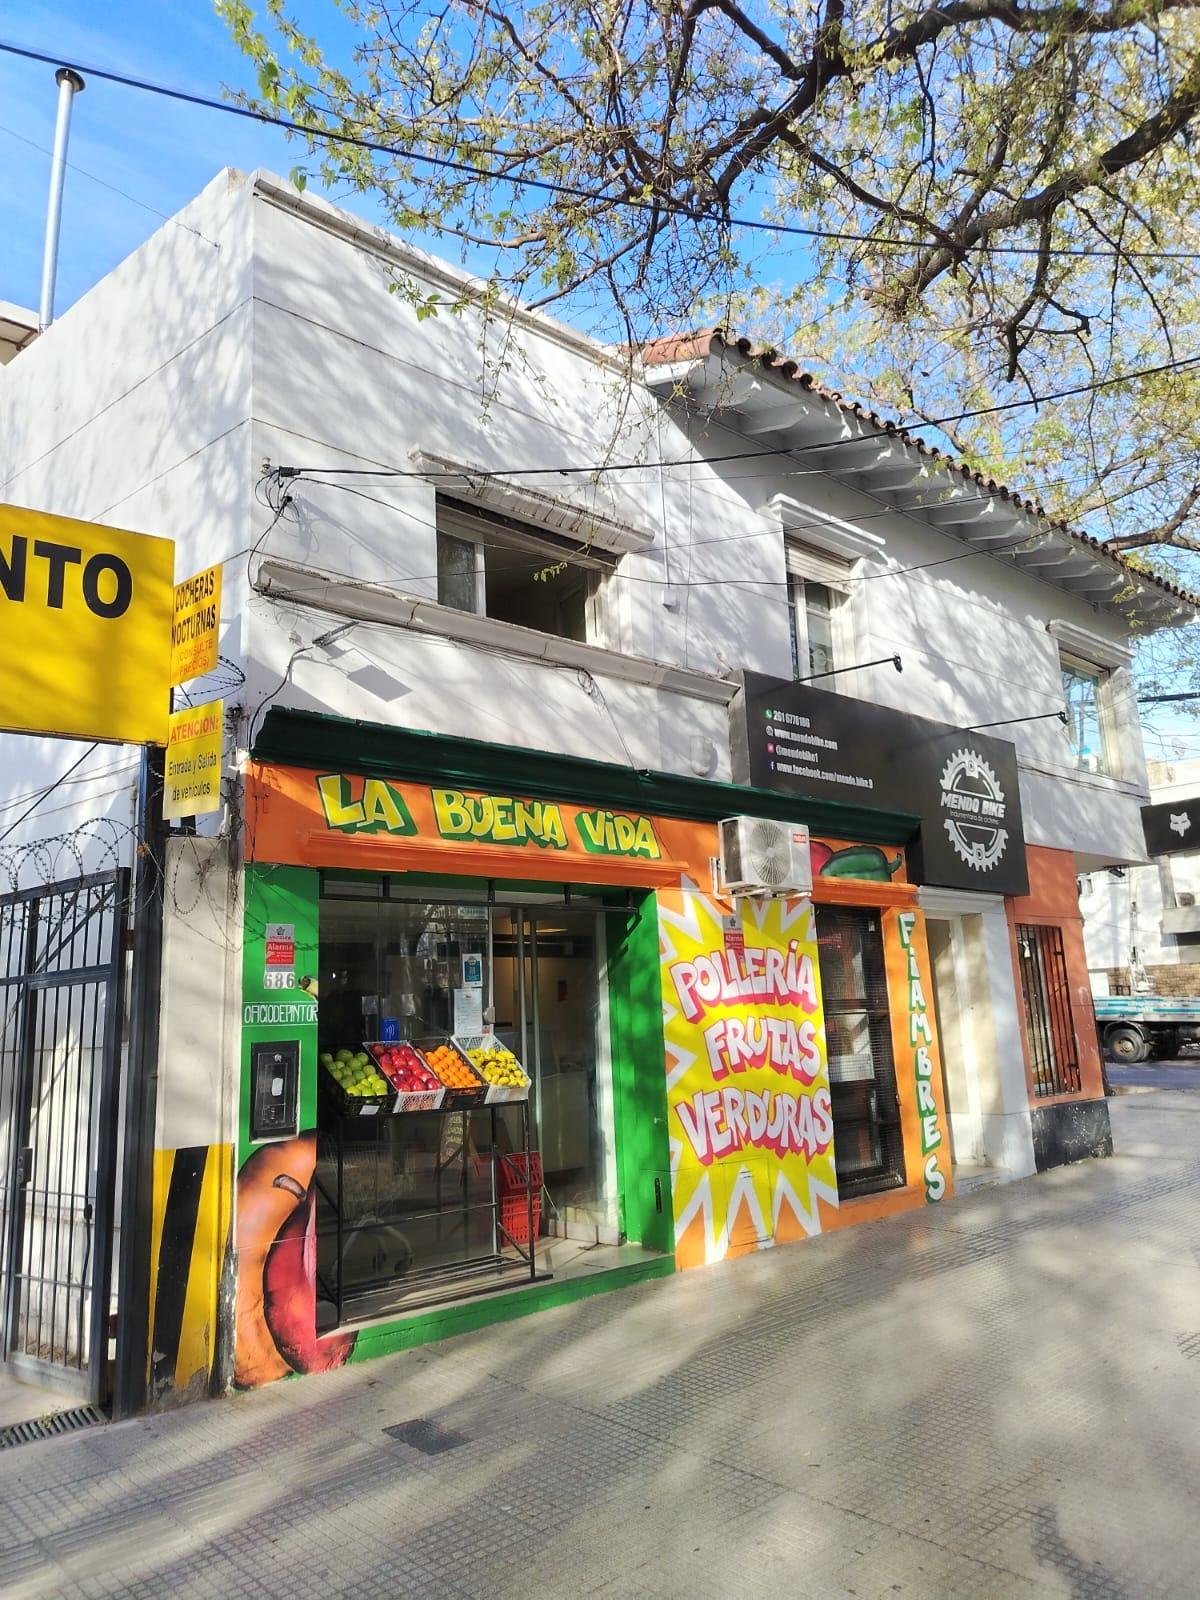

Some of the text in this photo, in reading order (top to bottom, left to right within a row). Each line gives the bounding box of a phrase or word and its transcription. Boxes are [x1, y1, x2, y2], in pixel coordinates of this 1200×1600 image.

[175, 570, 215, 612] COCHERAS
[171, 604, 216, 648] NOCTURNAS
[170, 715, 219, 742] ATENCION:
[168, 752, 217, 777] Entrada y Salida
[172, 785, 180, 801] de
[940, 791, 1006, 818] MENDO BIKE
[316, 774, 412, 834] LA
[432, 788, 567, 848] BUENA
[264, 973, 295, 989] 686
[703, 1015, 822, 1086] FRUTAS
[674, 1087, 834, 1166] VERDURAS
